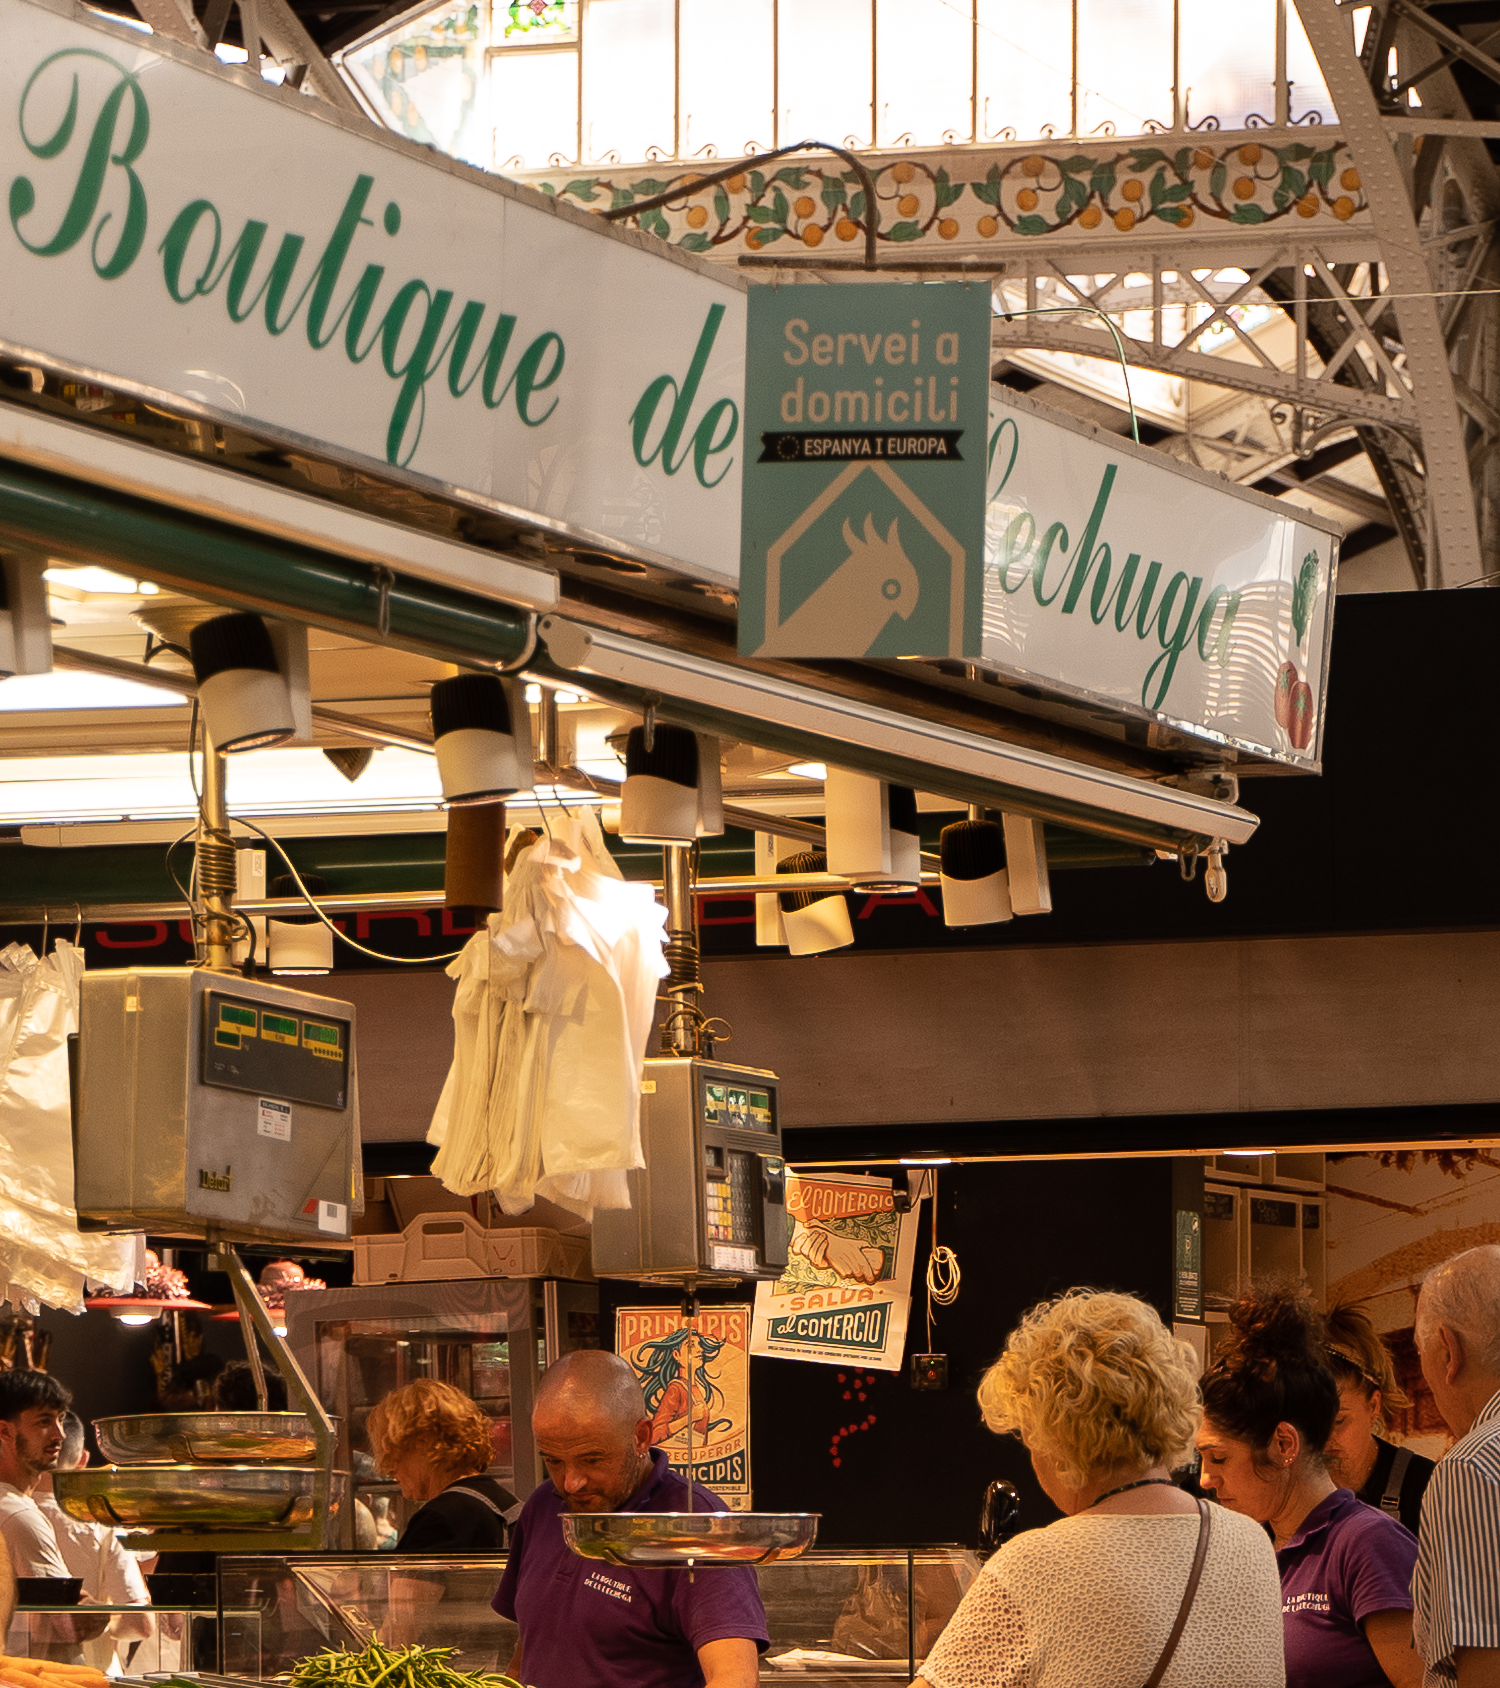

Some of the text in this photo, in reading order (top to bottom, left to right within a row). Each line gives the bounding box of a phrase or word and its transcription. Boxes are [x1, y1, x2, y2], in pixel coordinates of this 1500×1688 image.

[9, 48, 566, 469] Boutique
[628, 303, 740, 489] de
[783, 318, 959, 367] Servei a
[780, 376, 960, 425] domicili
[803, 437, 871, 457] ESPANYA
[887, 437, 948, 456] EUROPA
[811, 1187, 894, 1217] COMERCIO
[789, 1287, 875, 1312] SALVA
[776, 1309, 882, 1344] al COMERCIO
